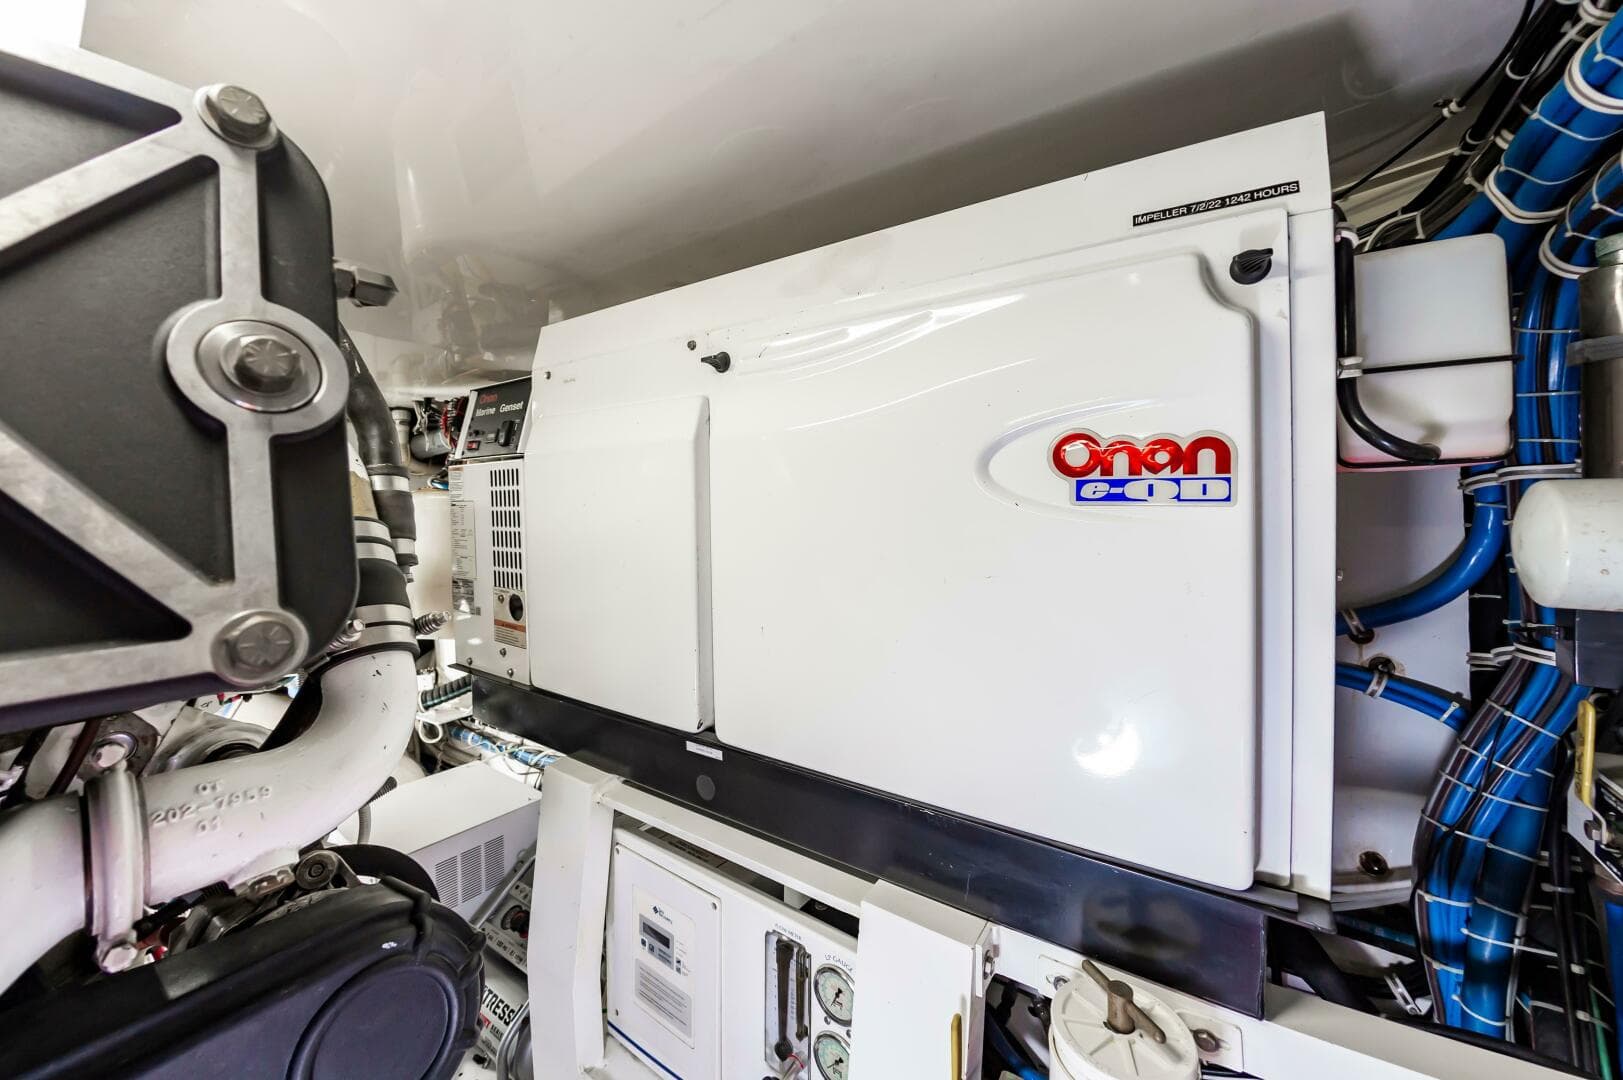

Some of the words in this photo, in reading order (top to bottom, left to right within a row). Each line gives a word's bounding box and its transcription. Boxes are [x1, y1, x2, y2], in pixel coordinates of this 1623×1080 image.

[1134, 206, 1187, 225] IMPELLER
[1190, 199, 1223, 214] 7/2/22
[1225, 192, 1252, 207] 1242
[1253, 183, 1299, 200] HOURS
[475, 407, 496, 417] Marine
[500, 401, 524, 413] Genset
